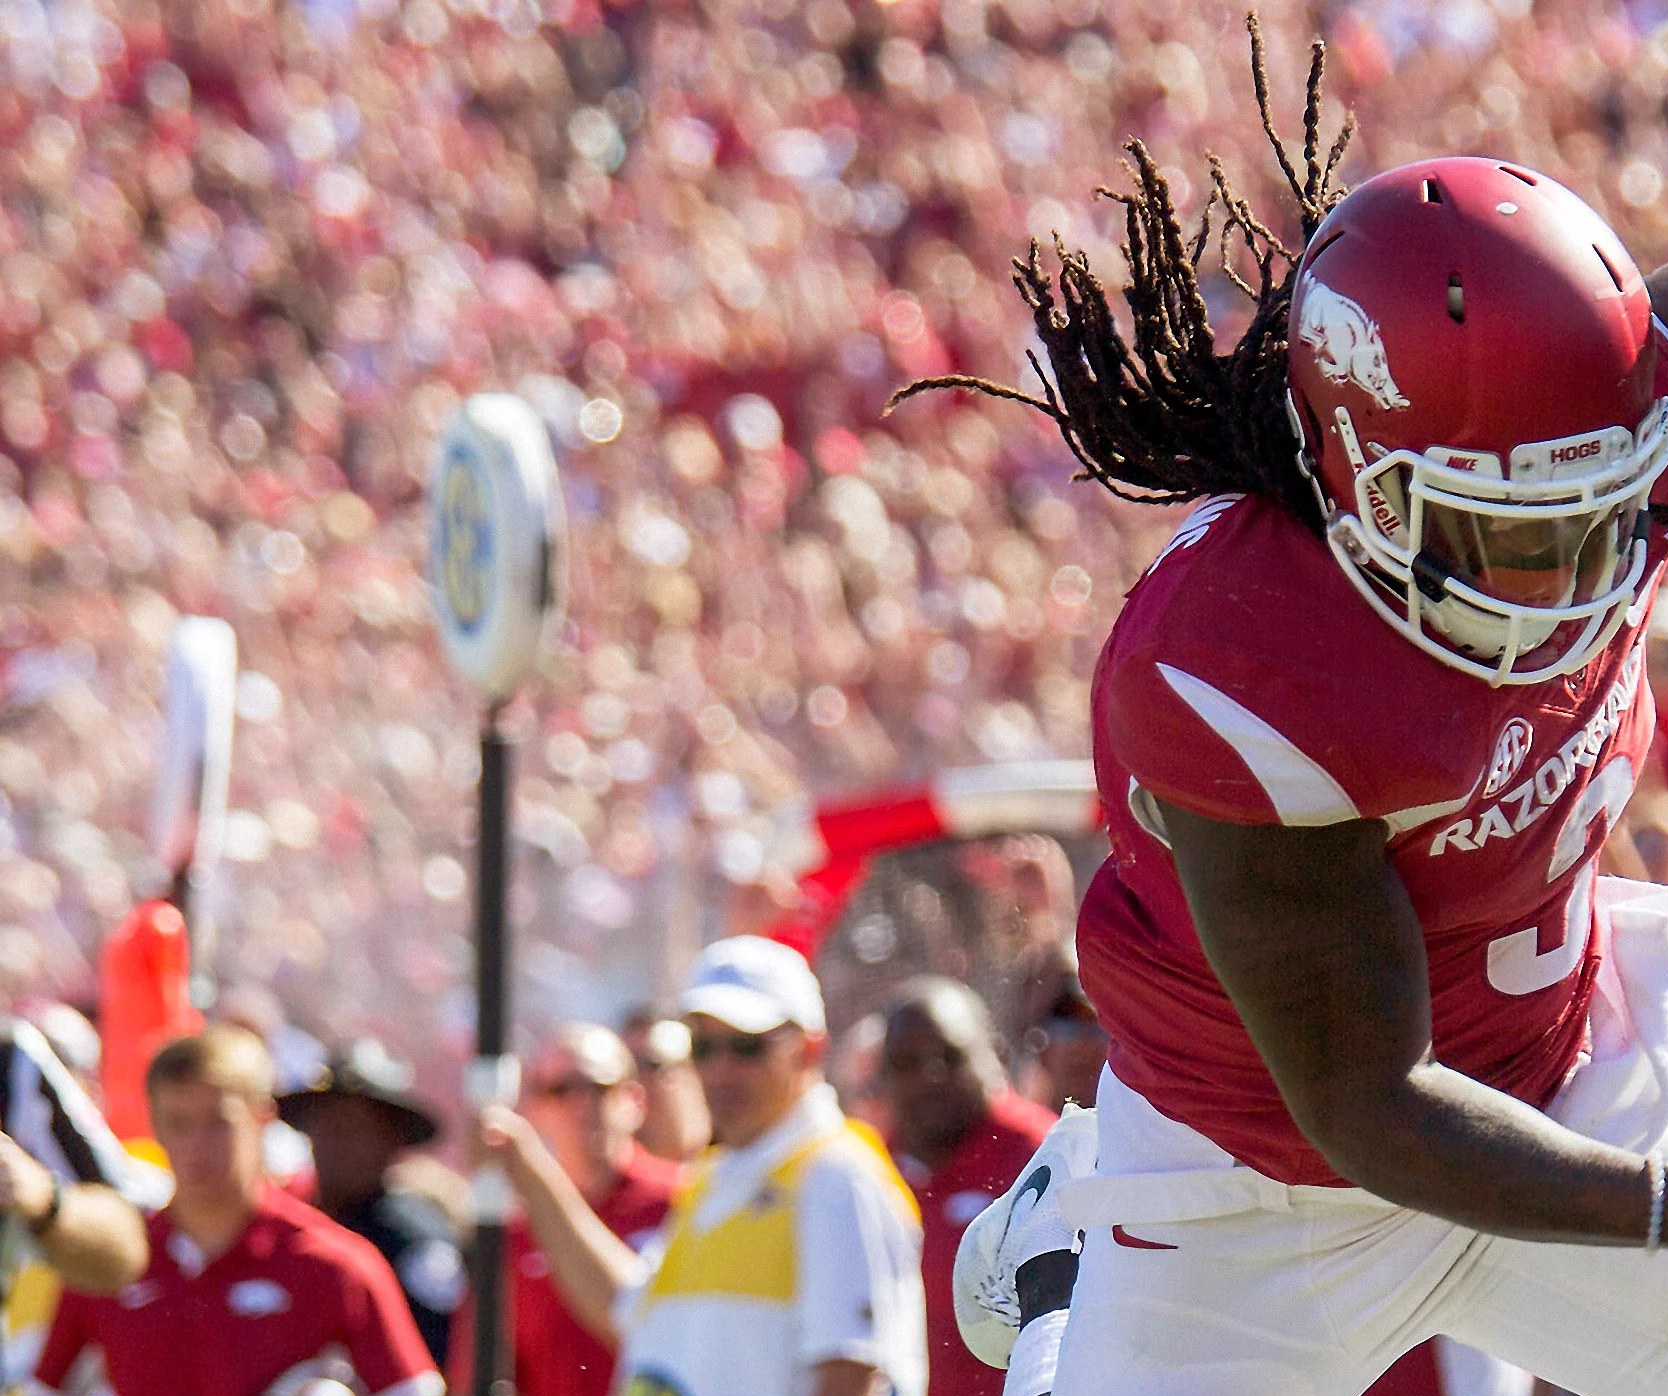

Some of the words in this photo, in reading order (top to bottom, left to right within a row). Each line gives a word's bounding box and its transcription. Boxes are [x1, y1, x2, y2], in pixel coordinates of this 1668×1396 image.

[1446, 455, 1478, 472] NIKE
[1550, 439, 1601, 464] HOGS
[1486, 754, 1636, 996] 3
